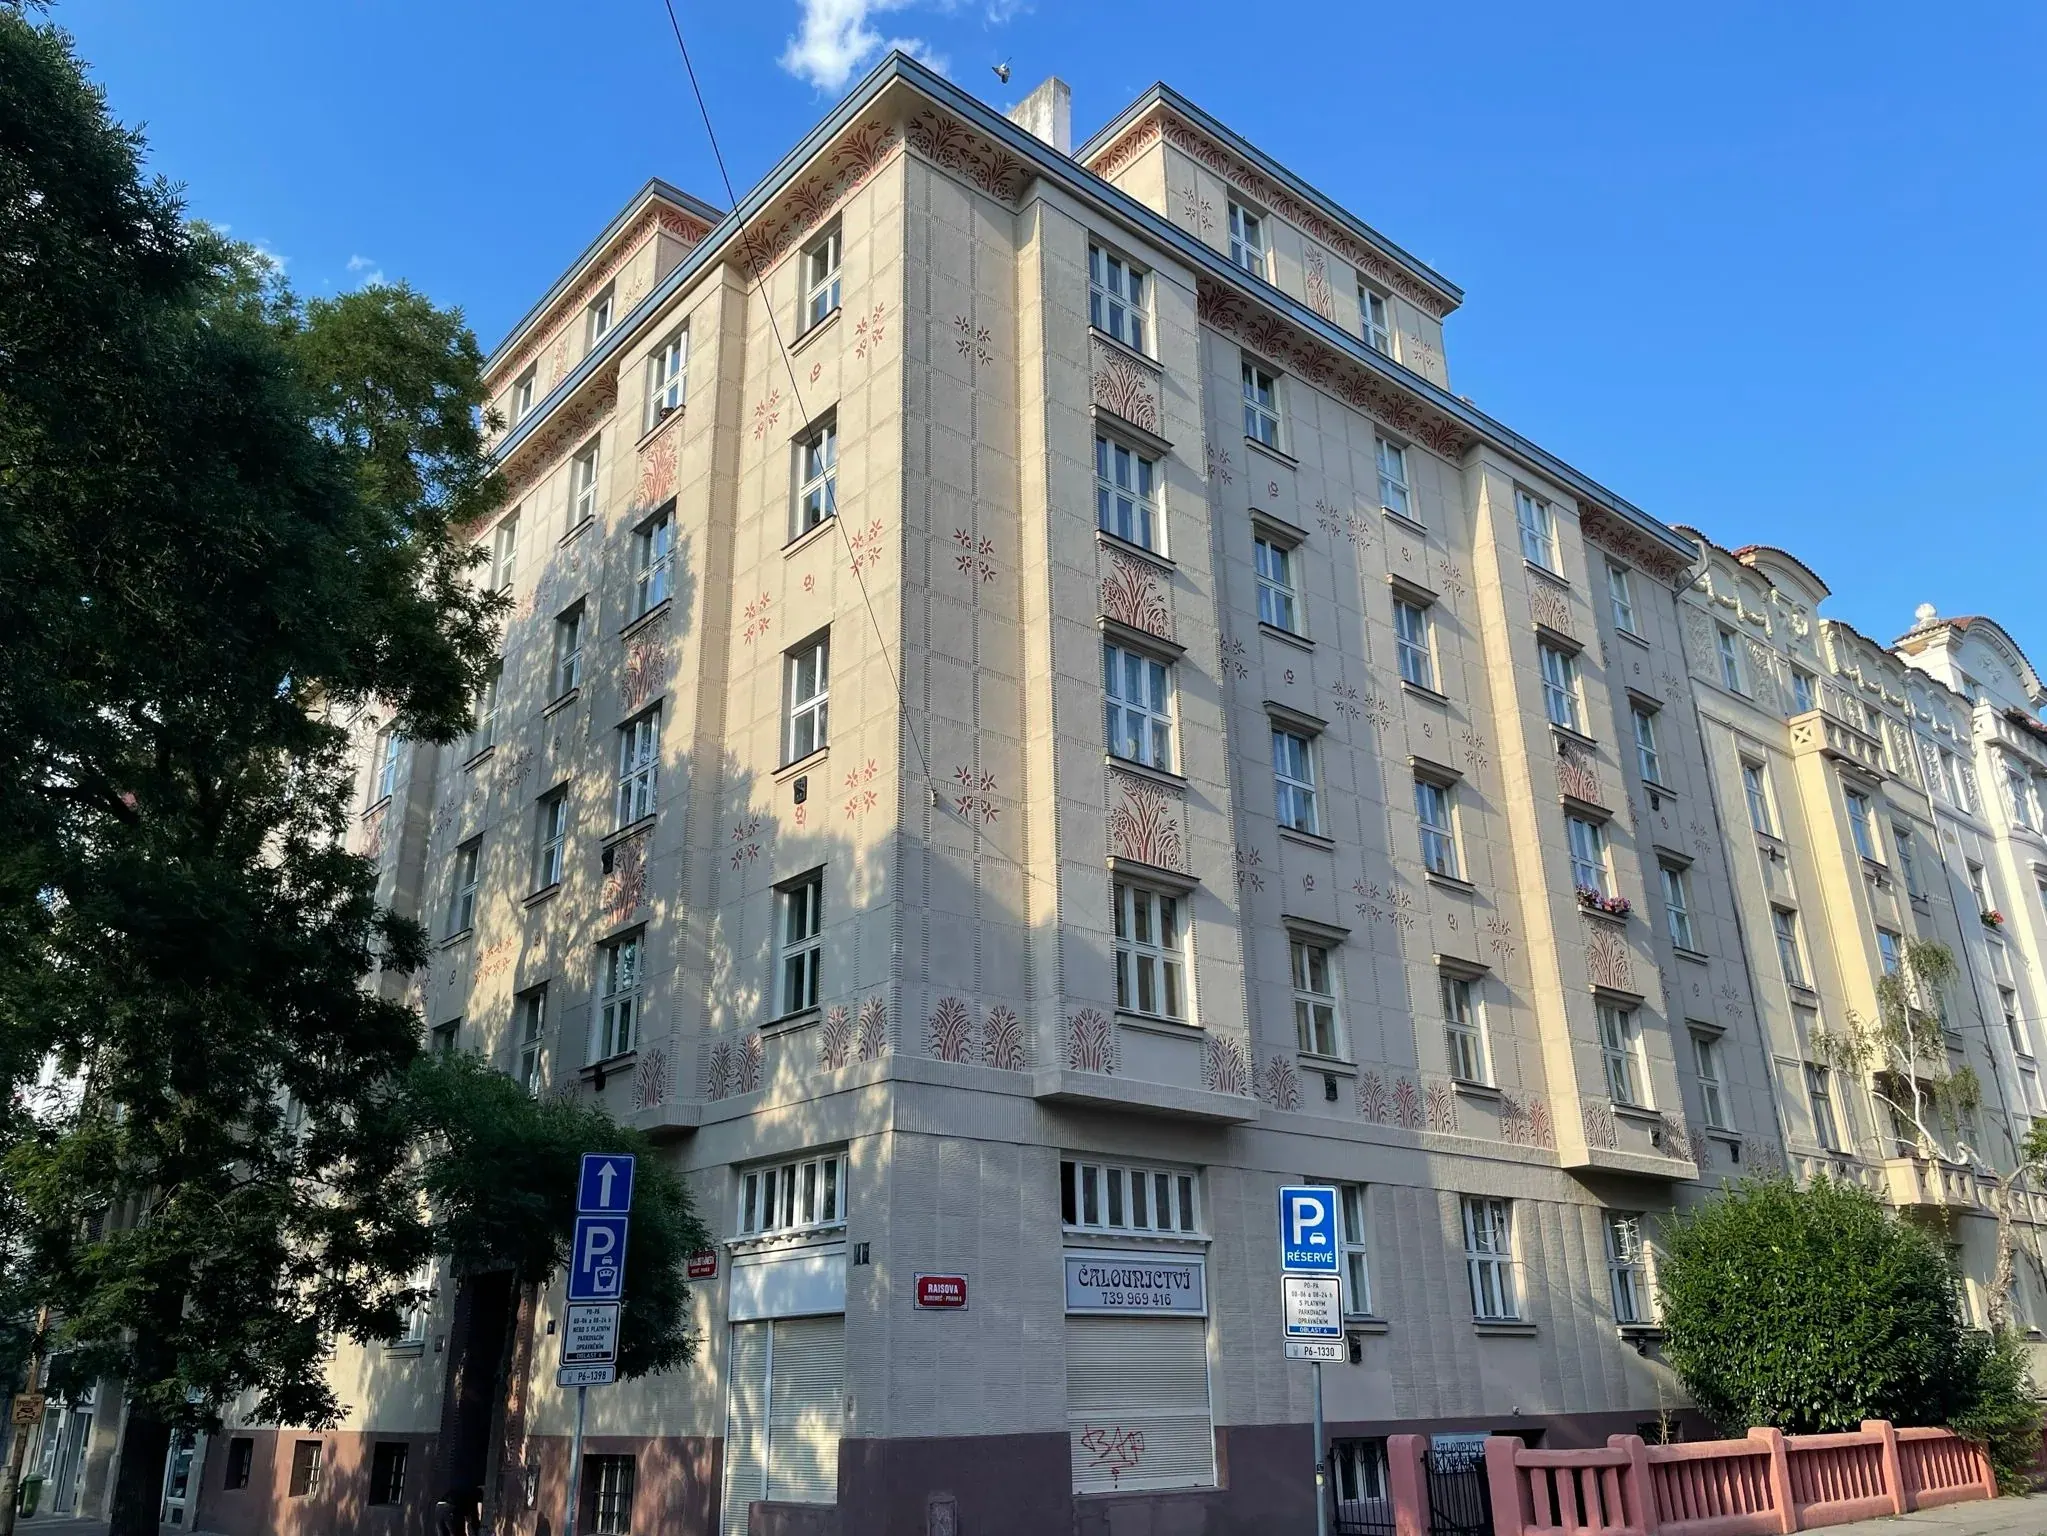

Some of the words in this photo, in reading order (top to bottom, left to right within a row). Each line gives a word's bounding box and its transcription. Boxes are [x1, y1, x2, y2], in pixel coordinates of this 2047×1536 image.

[1292, 1197, 1325, 1245] P
[583, 1226, 616, 1273] P
[1287, 1249, 1333, 1263] RÉSERVÉ
[1078, 1263, 1191, 1290] ČALOUNICTVÍ
[927, 1283, 959, 1294] RAISOVA
[1101, 1291, 1124, 1305] 739
[1127, 1292, 1149, 1306] 969
[1152, 1293, 1172, 1306] 416
[1299, 1326, 1322, 1334] OBLAST
[1304, 1346, 1335, 1357] P6-1330
[577, 1370, 607, 1381] P6-1398
